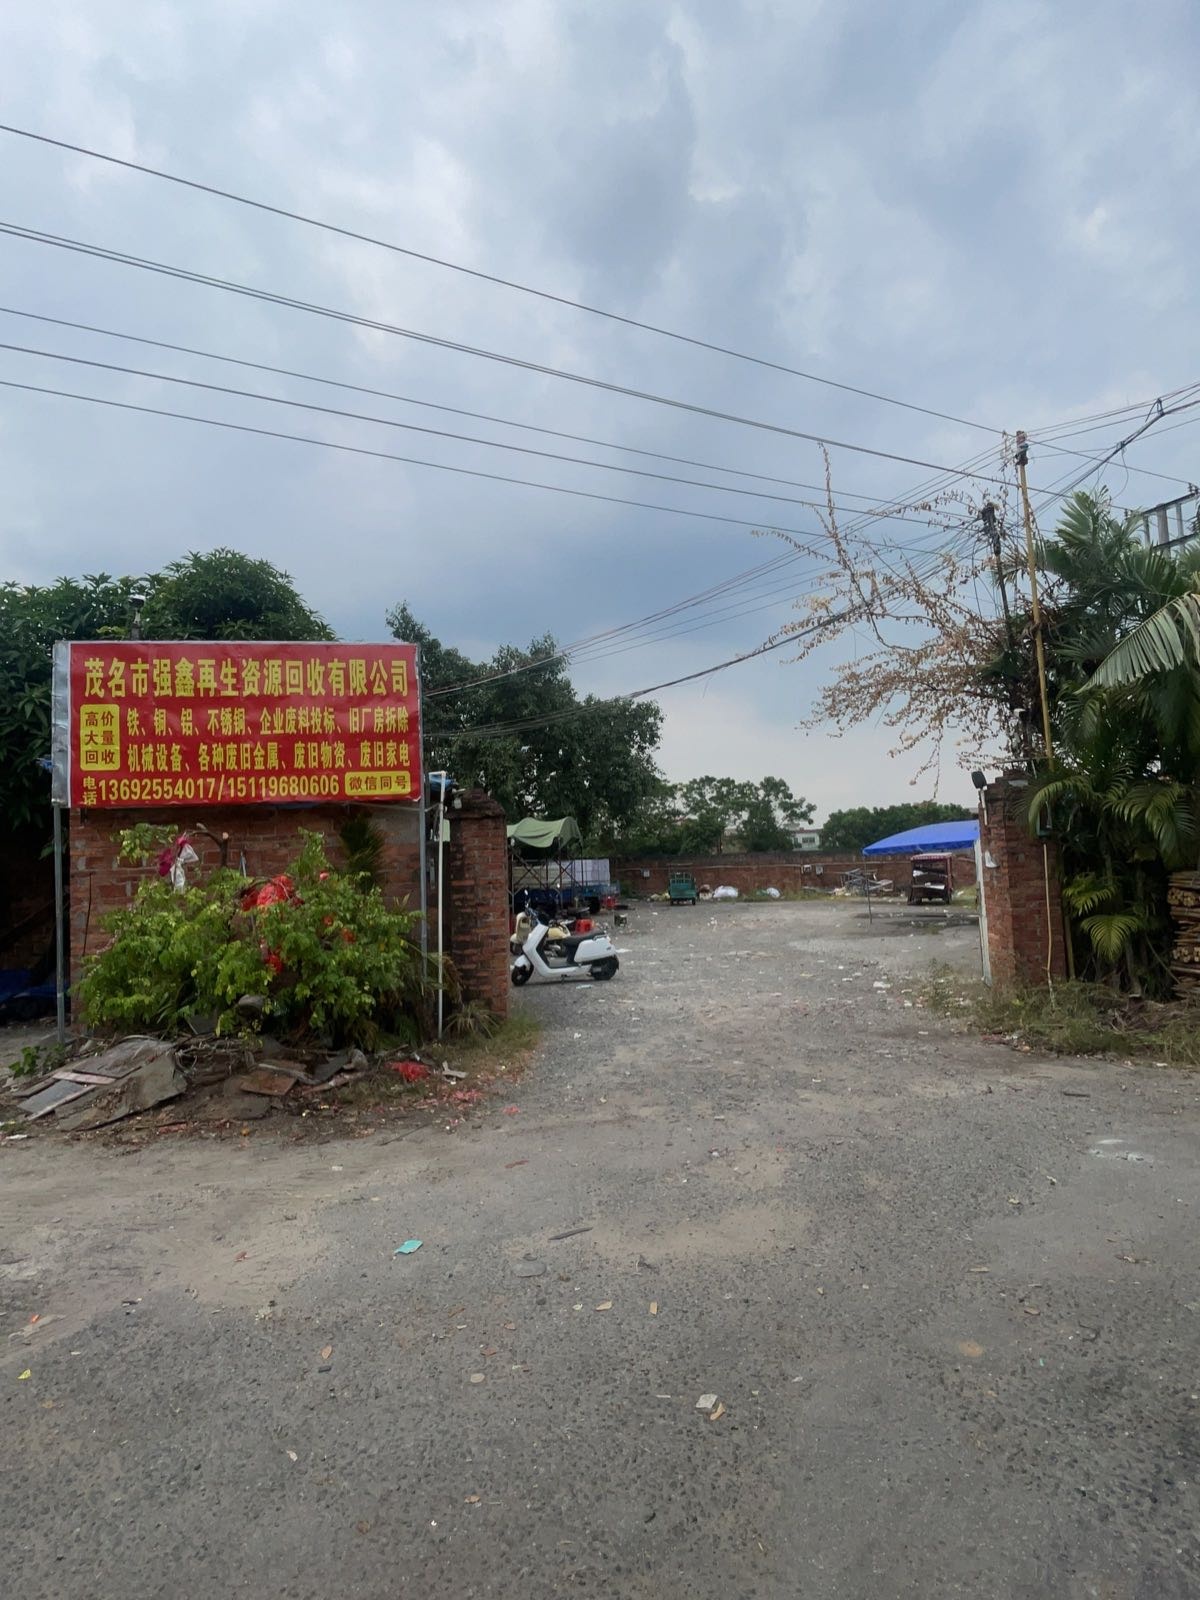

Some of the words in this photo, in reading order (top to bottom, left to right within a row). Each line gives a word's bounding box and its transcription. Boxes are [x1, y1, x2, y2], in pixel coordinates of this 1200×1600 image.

[84, 657, 408, 698] 茂名市强鑫再生资源回收有限公司
[85, 711, 114, 727] 高价
[85, 730, 114, 746] 大量
[85, 749, 115, 765] 回收
[82, 776, 97, 805] 电话
[349, 776, 408, 792] 微信同号
